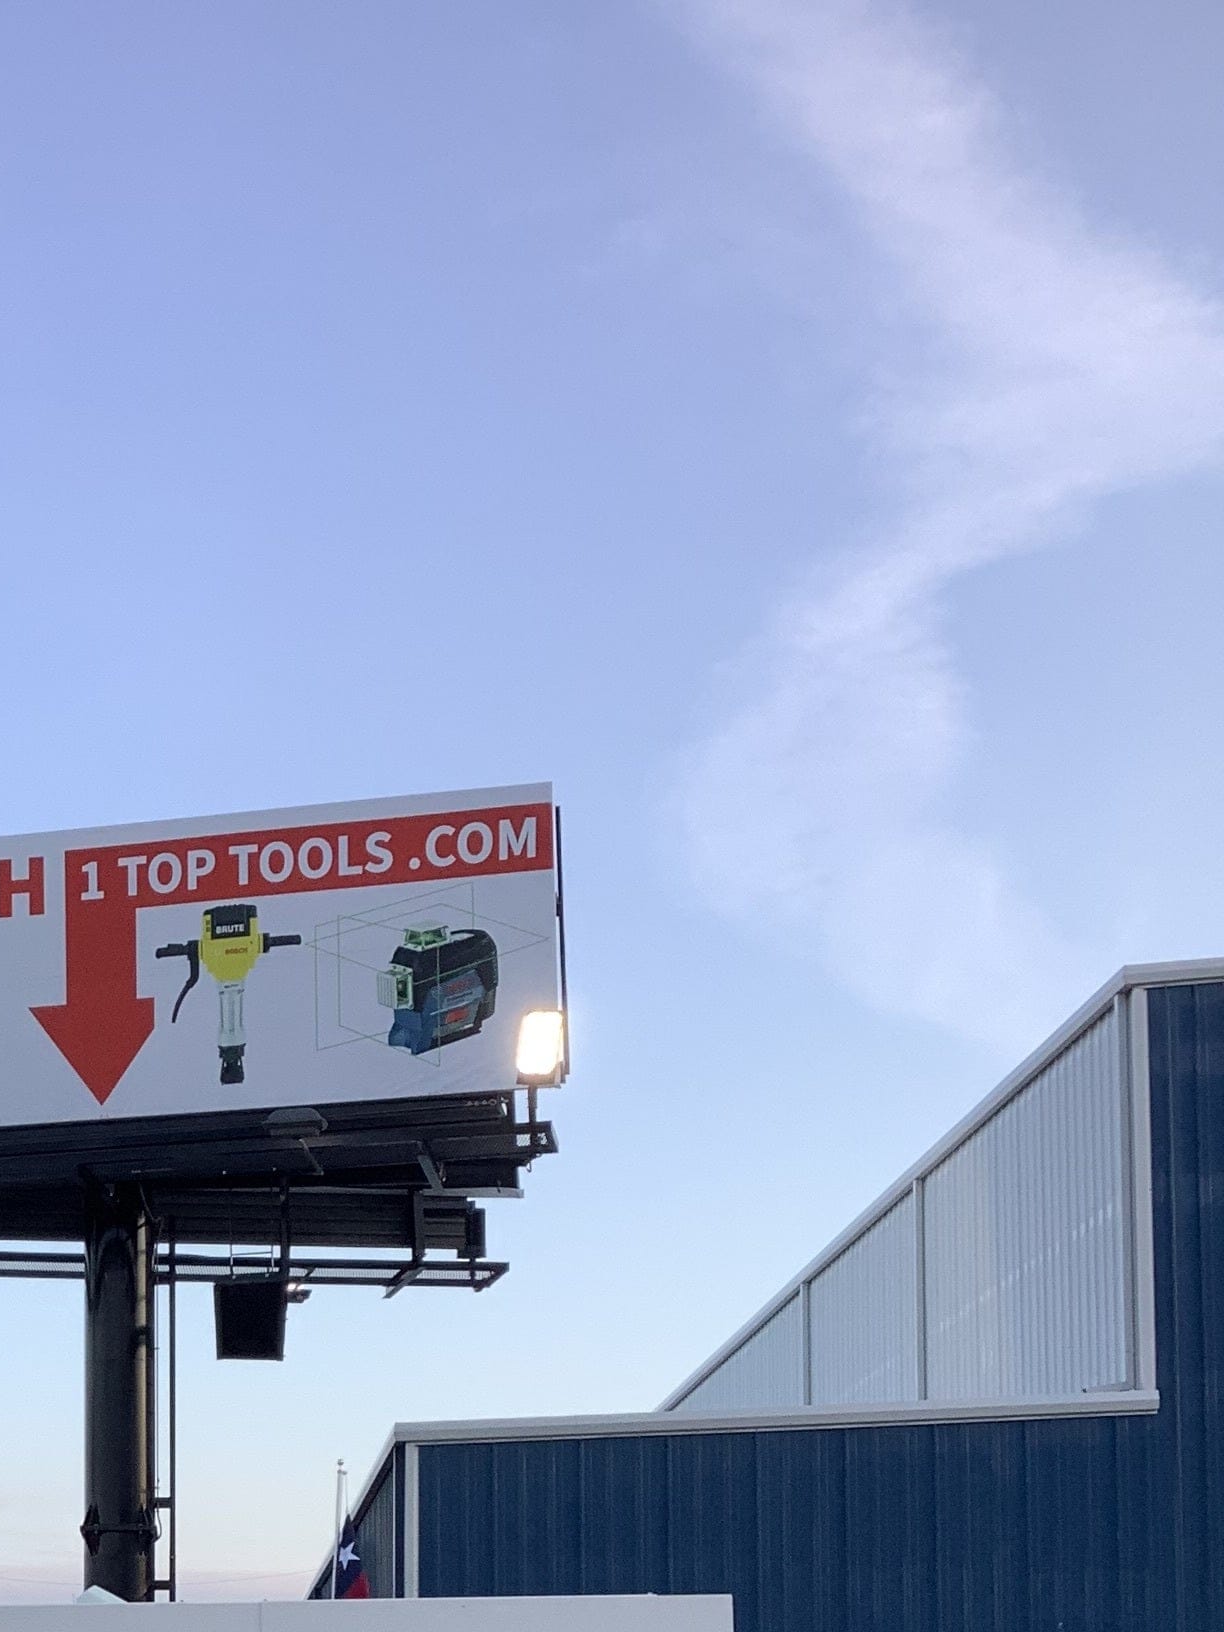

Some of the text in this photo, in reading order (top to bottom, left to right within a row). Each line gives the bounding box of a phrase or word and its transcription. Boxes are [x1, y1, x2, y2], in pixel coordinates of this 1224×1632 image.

[80, 816, 537, 900] 1 TOP TOOLS .COM
[216, 923, 245, 934] BRUTE
